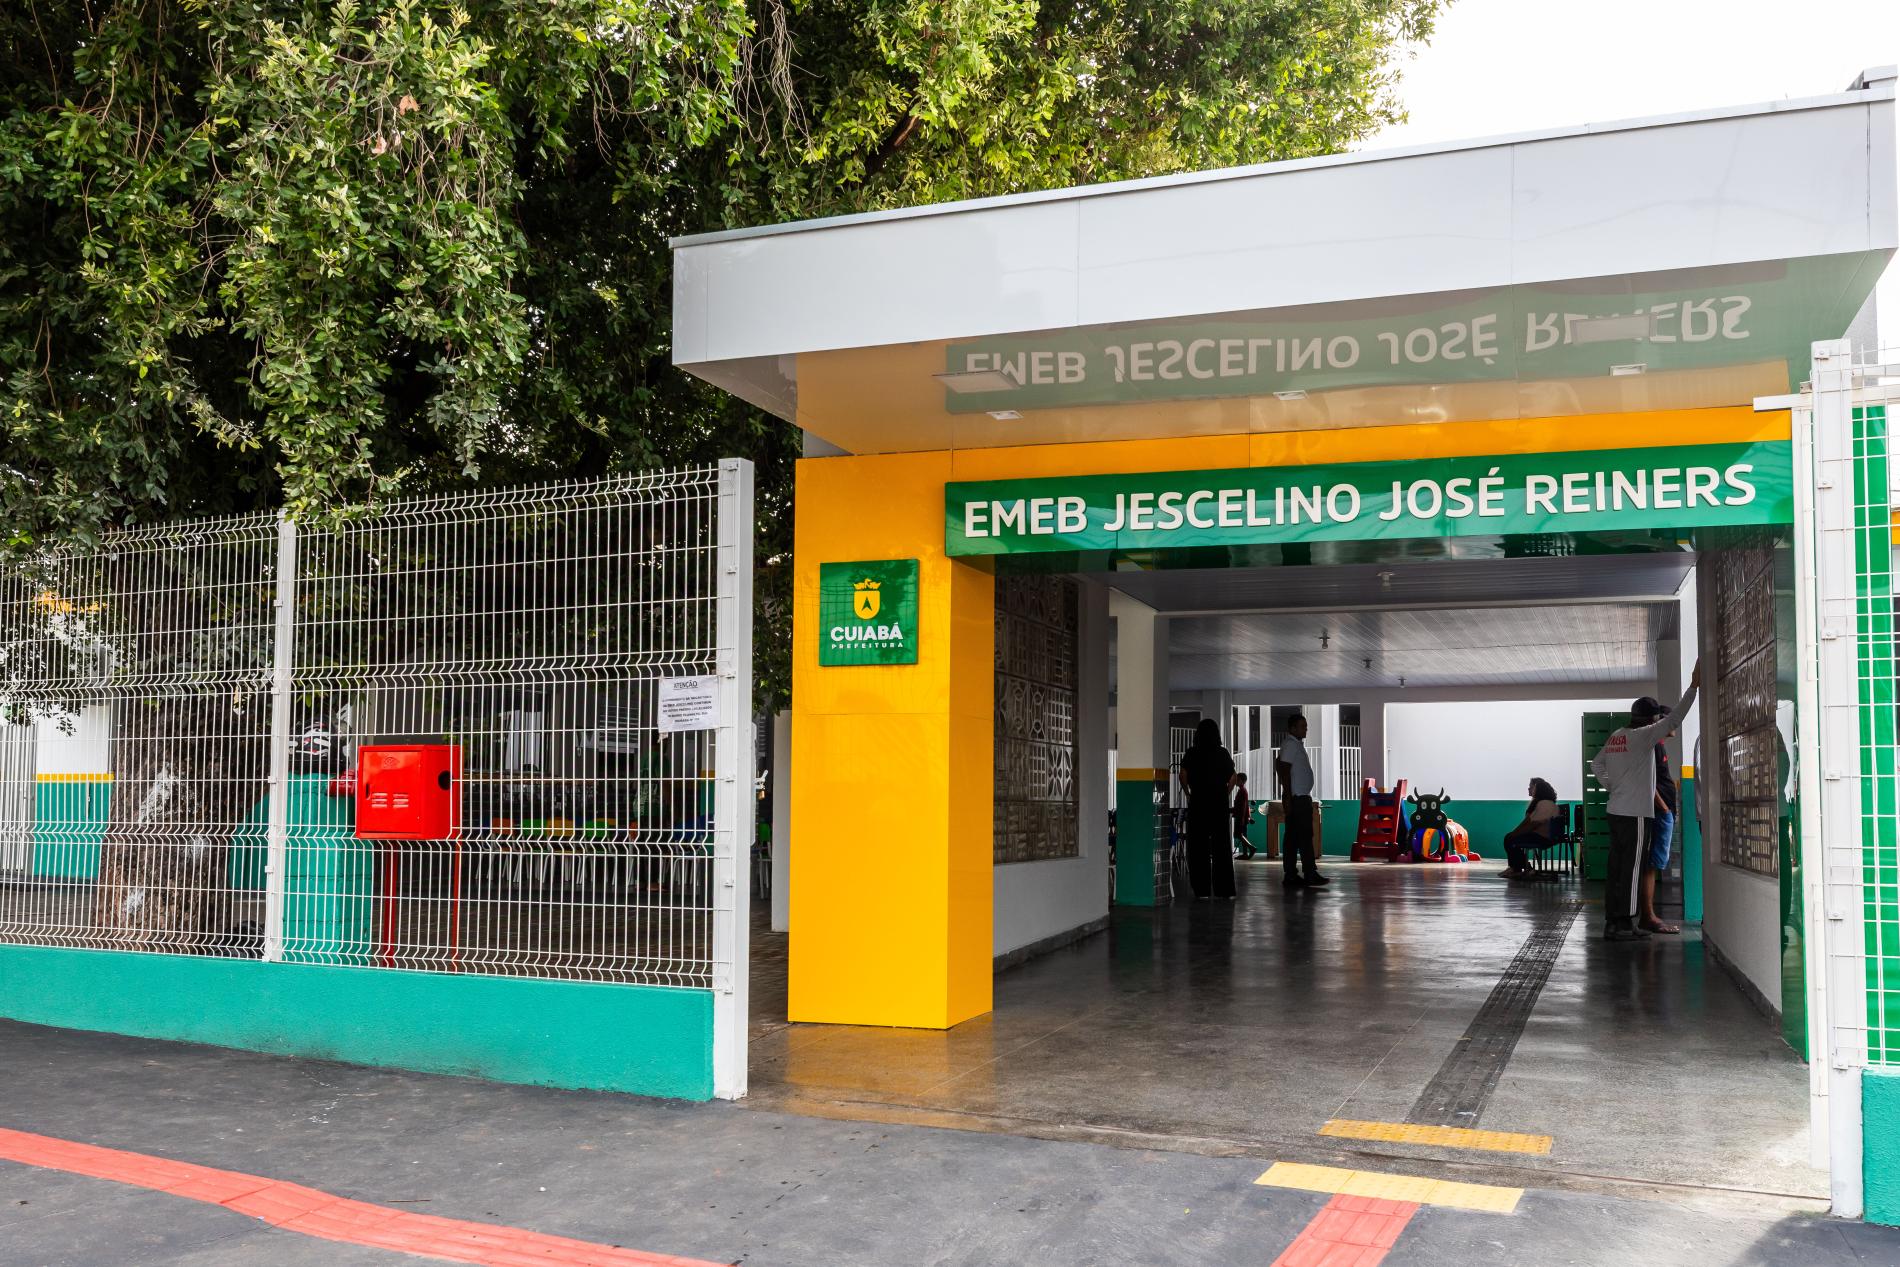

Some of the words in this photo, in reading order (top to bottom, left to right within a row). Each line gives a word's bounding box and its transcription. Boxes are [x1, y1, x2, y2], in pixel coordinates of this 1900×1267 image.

[965, 496, 1088, 538] EMEB
[1103, 483, 1361, 532] JESCELINO
[1379, 467, 1505, 521] JOSÉ
[1526, 464, 1756, 516] REINERS
[830, 622, 903, 642] CUIABÁ
[831, 642, 903, 650] PREFEITURA
[673, 680, 698, 689] ATENÇÃO
